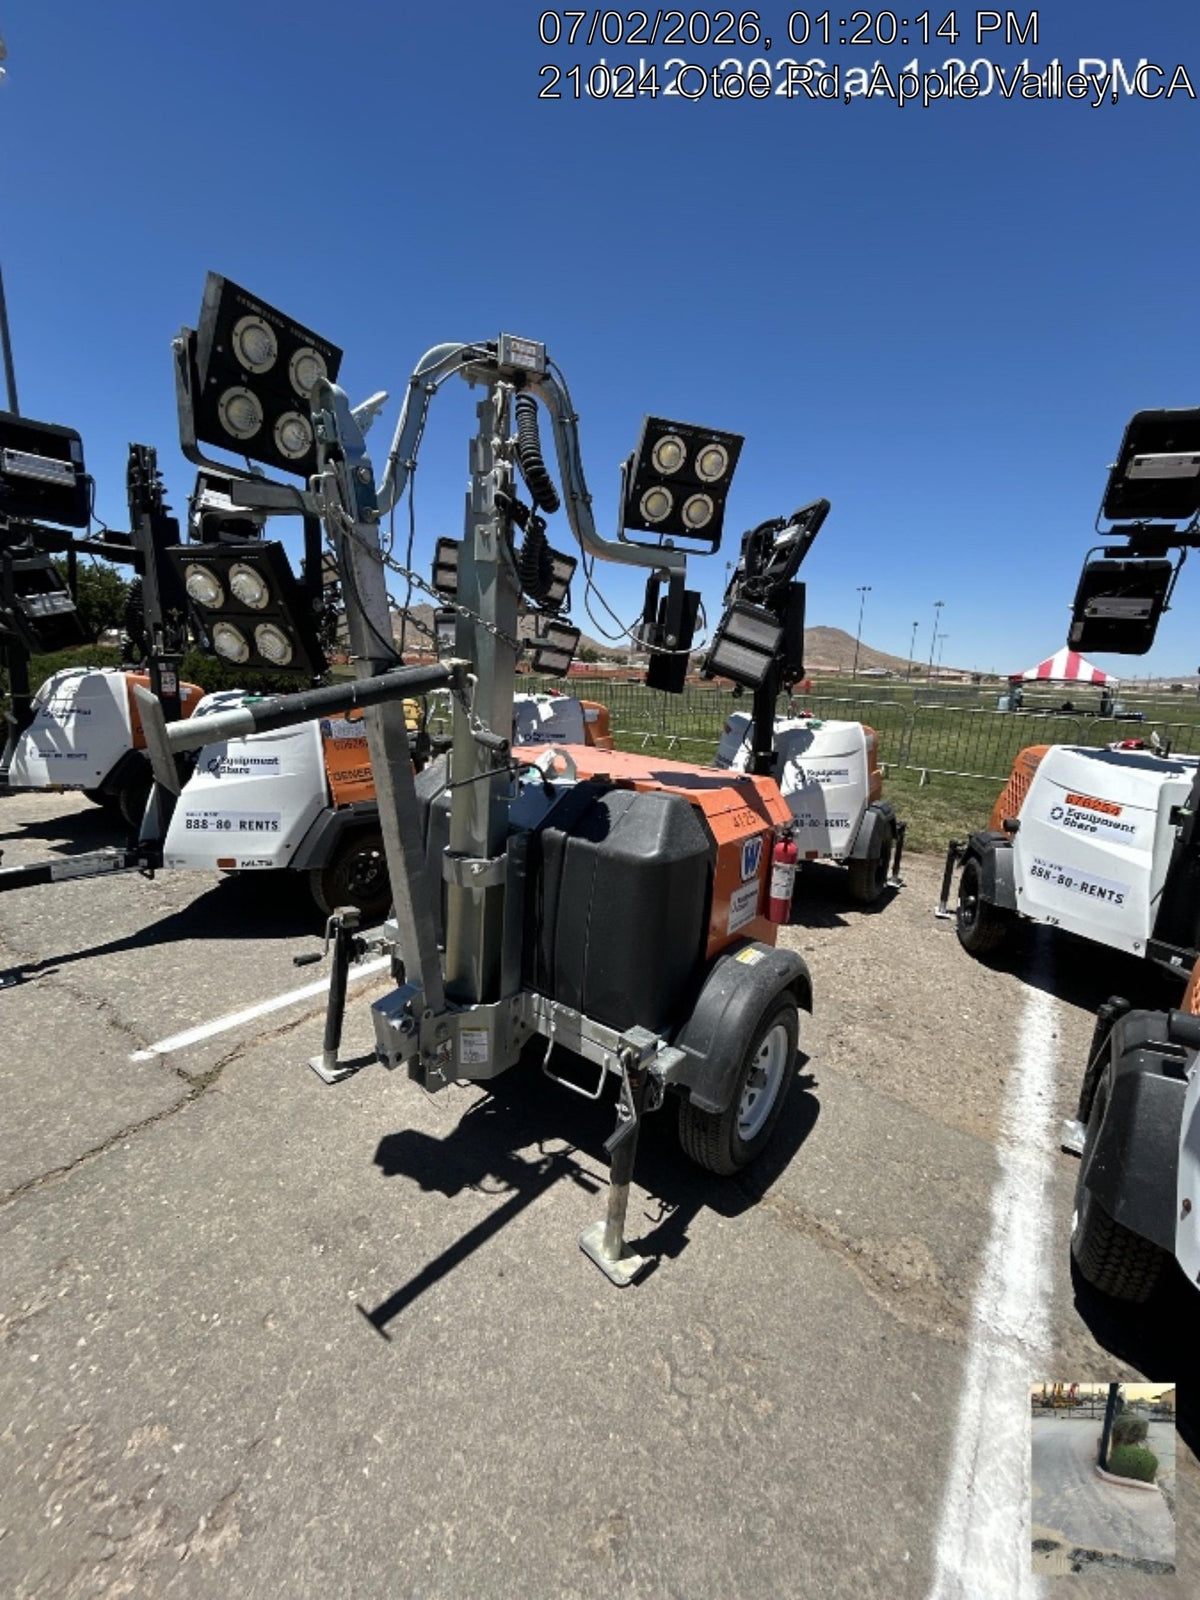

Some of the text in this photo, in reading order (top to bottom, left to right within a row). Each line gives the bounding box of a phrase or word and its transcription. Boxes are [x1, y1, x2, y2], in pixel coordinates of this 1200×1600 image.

[239, 820, 279, 832] RENTS
[1063, 817, 1098, 833] Share
[1066, 807, 1137, 835] Equipment
